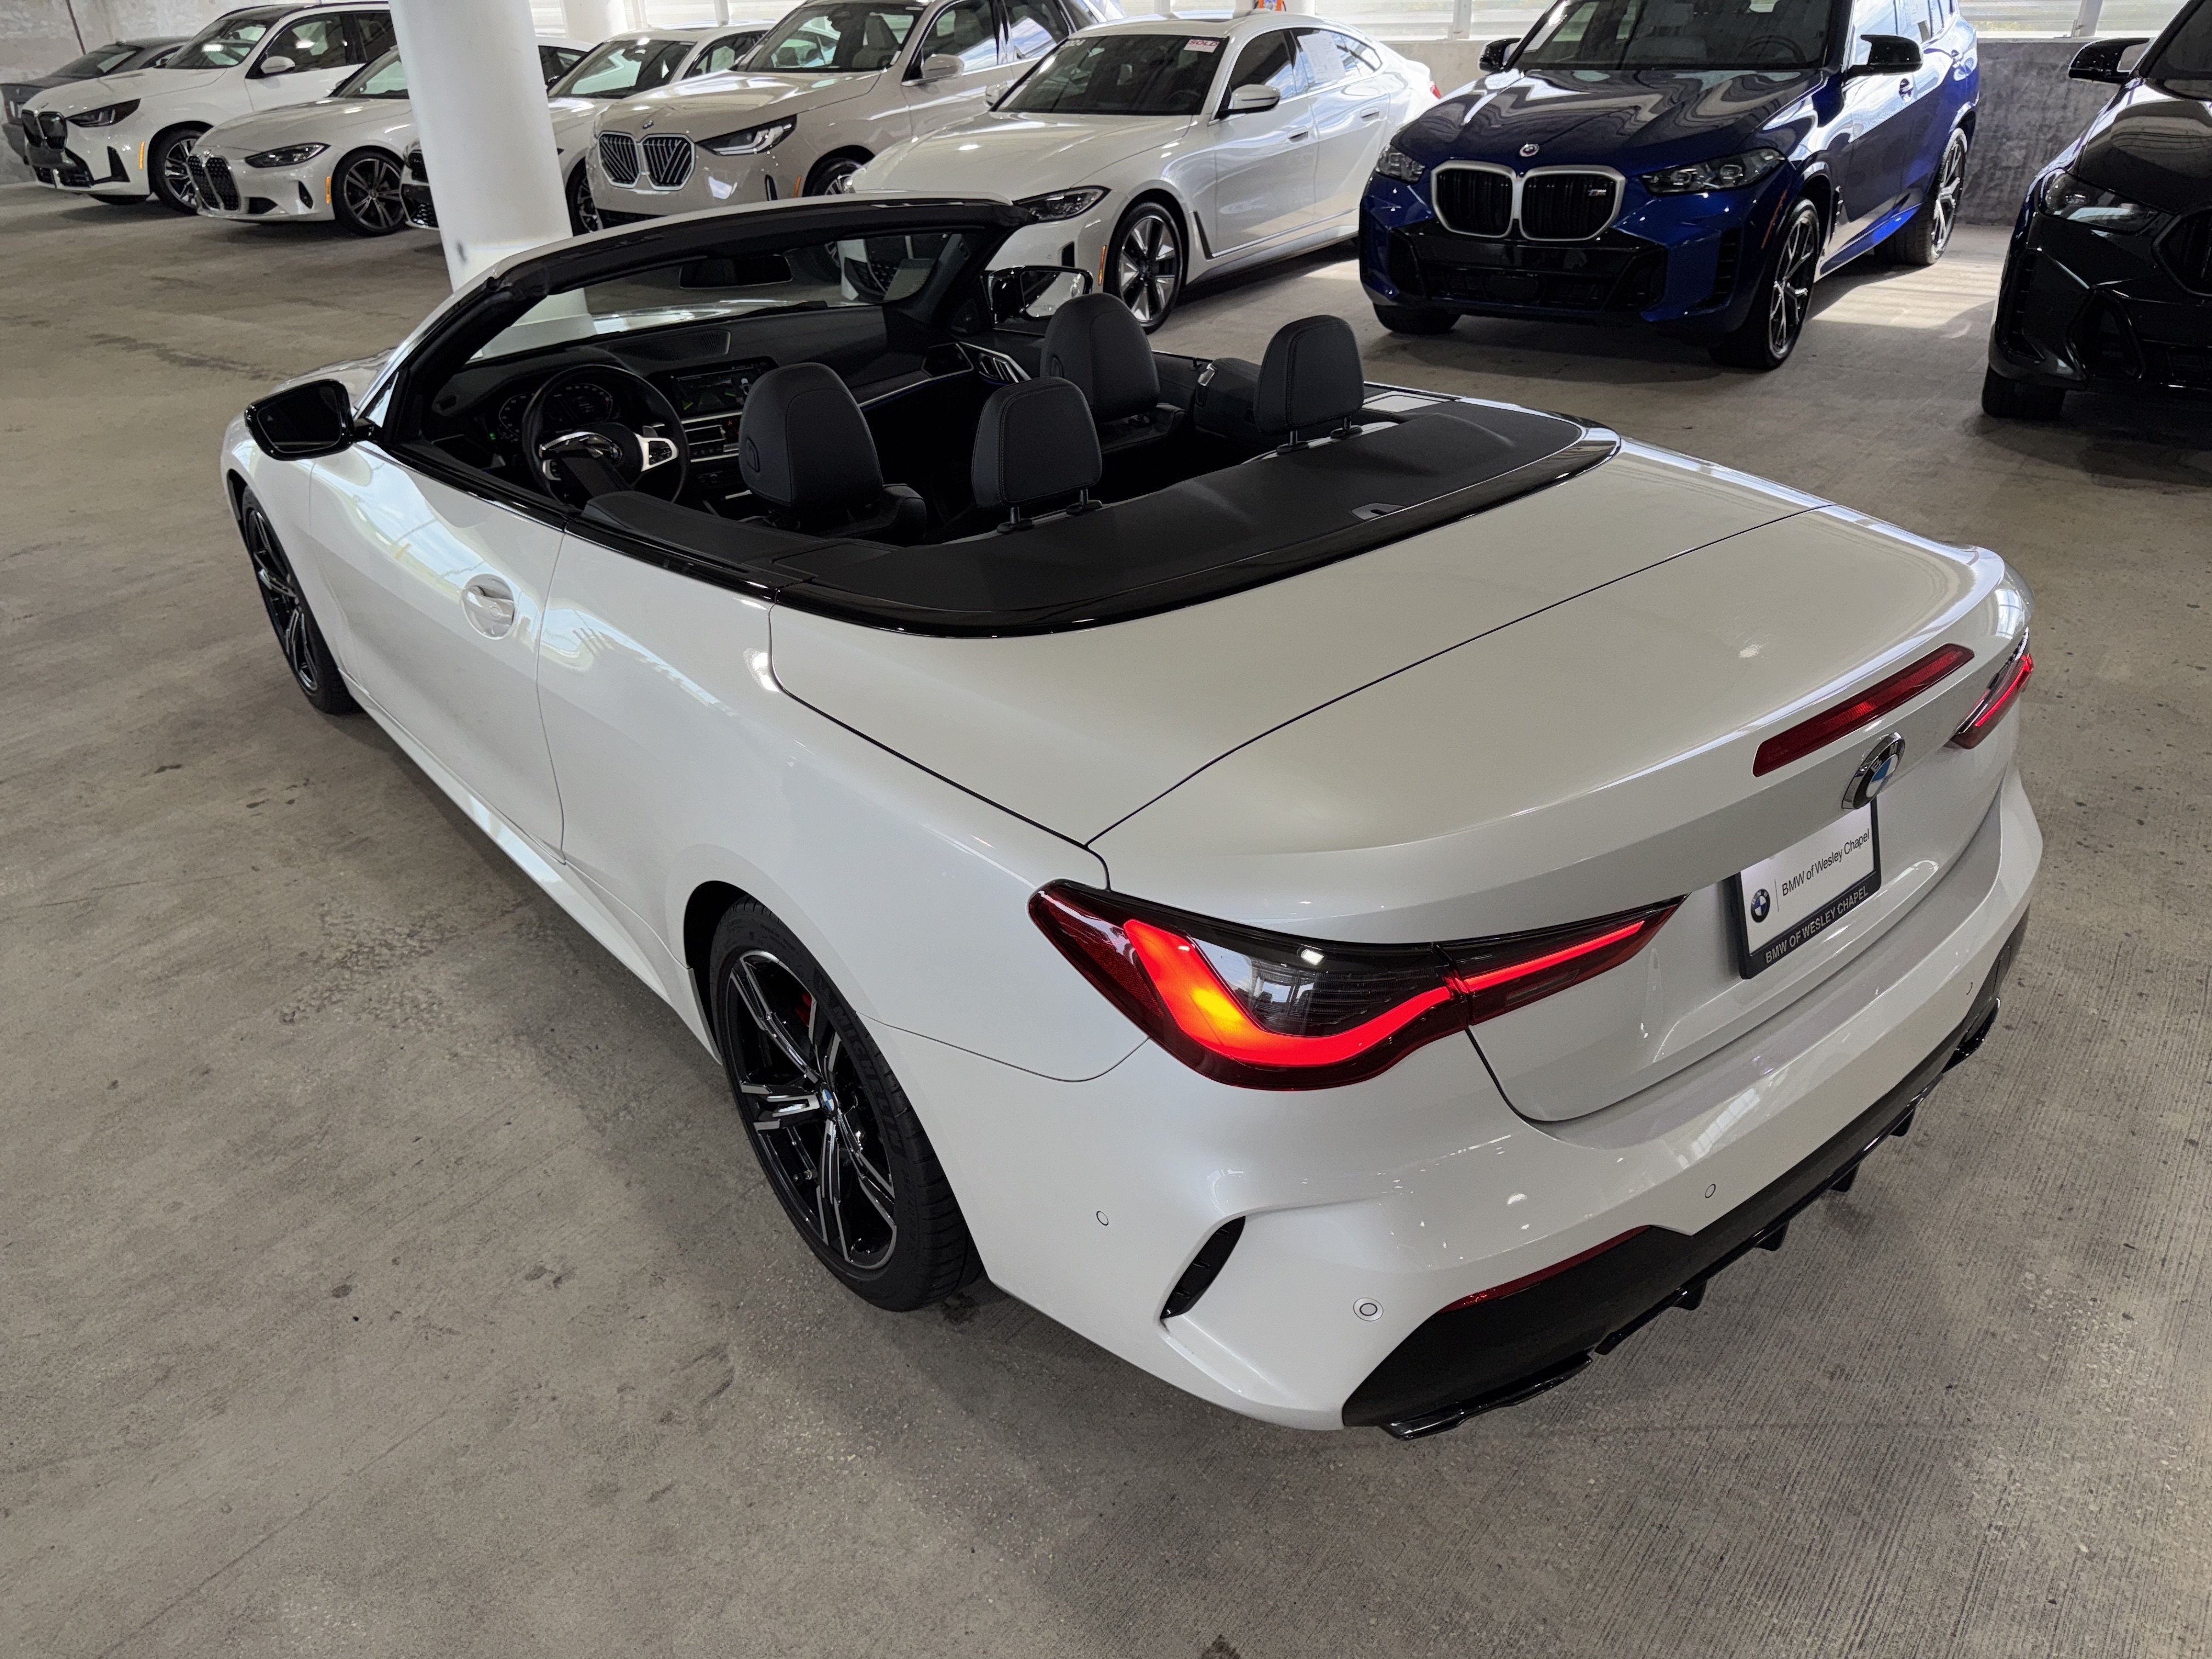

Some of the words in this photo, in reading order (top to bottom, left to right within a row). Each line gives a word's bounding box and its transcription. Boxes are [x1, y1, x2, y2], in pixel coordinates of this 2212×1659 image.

[1782, 871, 1804, 896] BMW
[1806, 865, 1814, 880] of
[1814, 849, 1843, 874] Wesley
[1844, 828, 1870, 854] Chapel
[1765, 939, 1787, 963] BMW
[1789, 931, 1802, 947] OF
[1802, 907, 1836, 939] WESLEY
[1837, 885, 1869, 915] CHAPEL
[832, 1005, 904, 1152] MICHELIN
